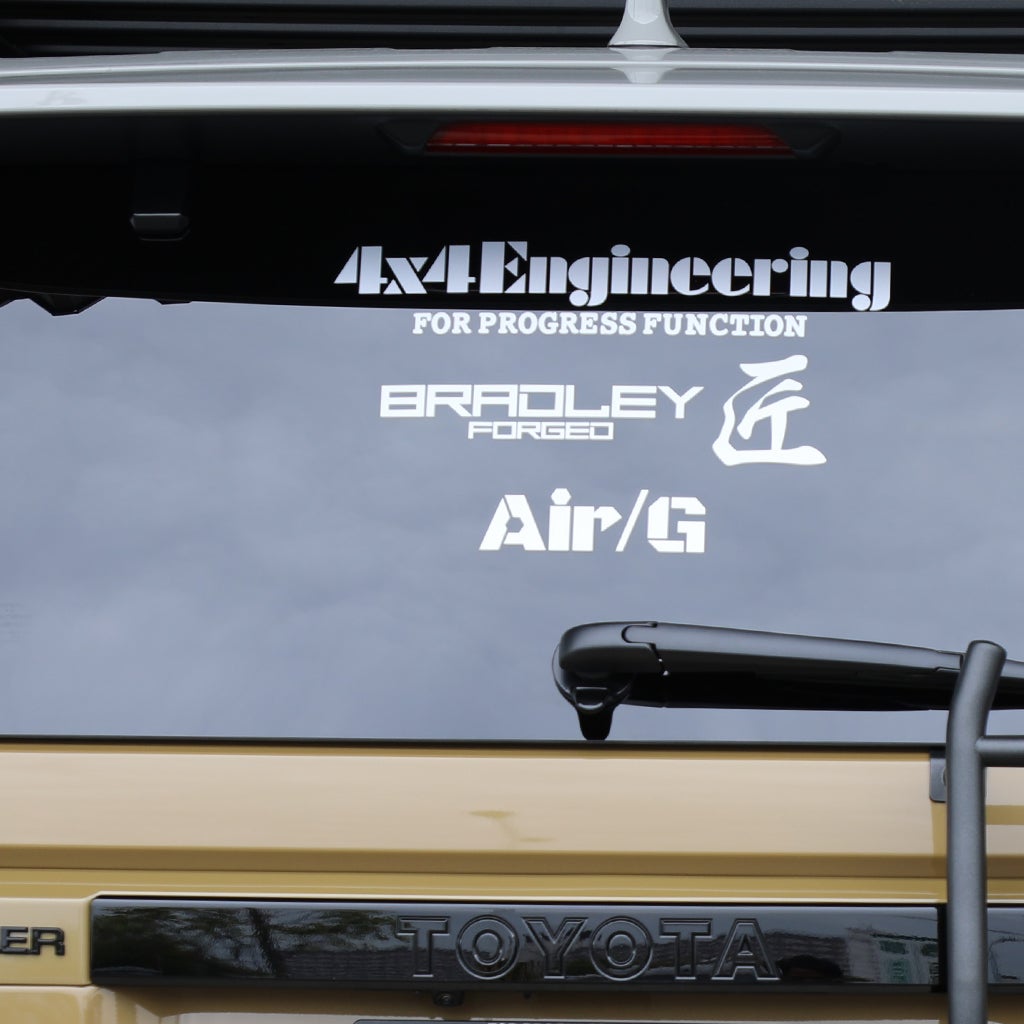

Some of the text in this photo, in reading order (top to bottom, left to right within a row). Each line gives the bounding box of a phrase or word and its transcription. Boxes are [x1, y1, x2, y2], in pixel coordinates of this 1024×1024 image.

[333, 241, 892, 311] 4x4Engineering
[412, 312, 808, 338] FOR PROGRESS FUNCTION
[380, 384, 704, 419] BRADLEY
[468, 421, 614, 440] FORGED
[711, 354, 828, 466] 匠
[479, 488, 707, 554] Air/G
[397, 914, 781, 981] TOYOTA
